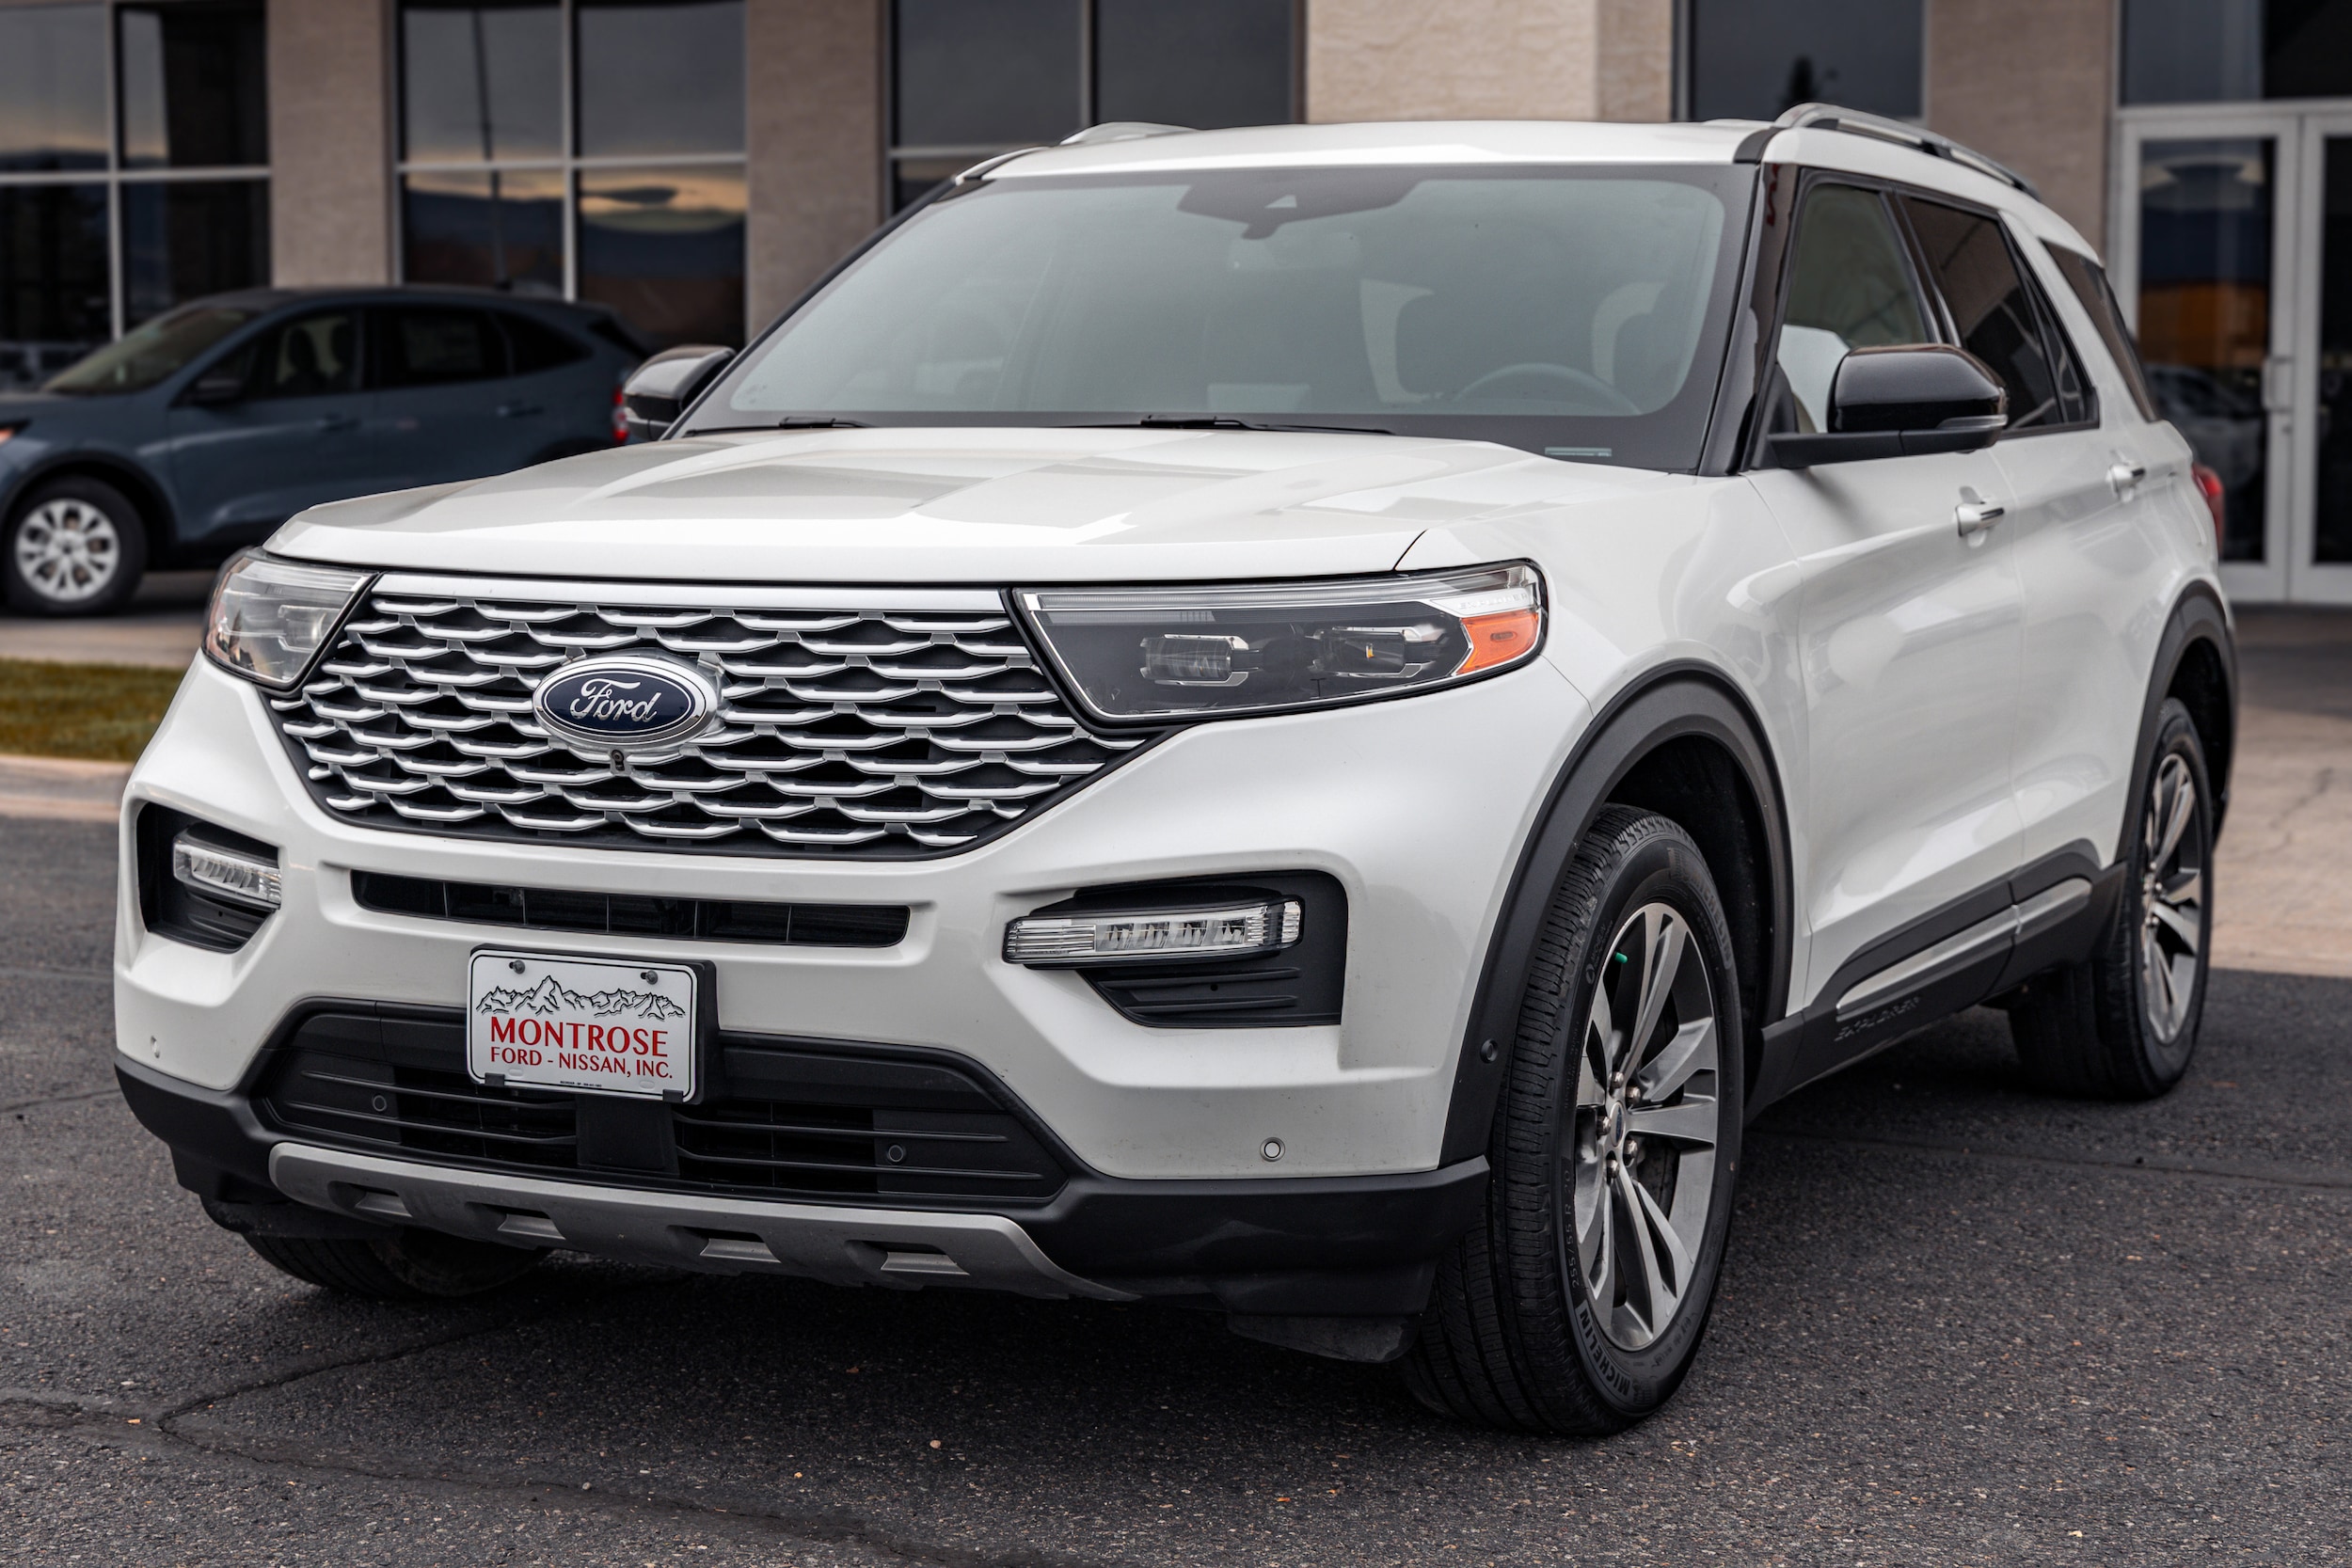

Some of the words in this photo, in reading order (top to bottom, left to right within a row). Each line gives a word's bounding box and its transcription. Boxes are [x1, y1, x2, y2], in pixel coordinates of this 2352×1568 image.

[569, 677, 662, 722] Ford
[490, 1016, 668, 1057] MONTROSE
[490, 1046, 542, 1066] FORD
[558, 1053, 631, 1078] NISSAN,
[636, 1060, 673, 1079] INC.
[1565, 1224, 1580, 1289] 255/55
[1580, 1308, 1630, 1397] MICHELIN
